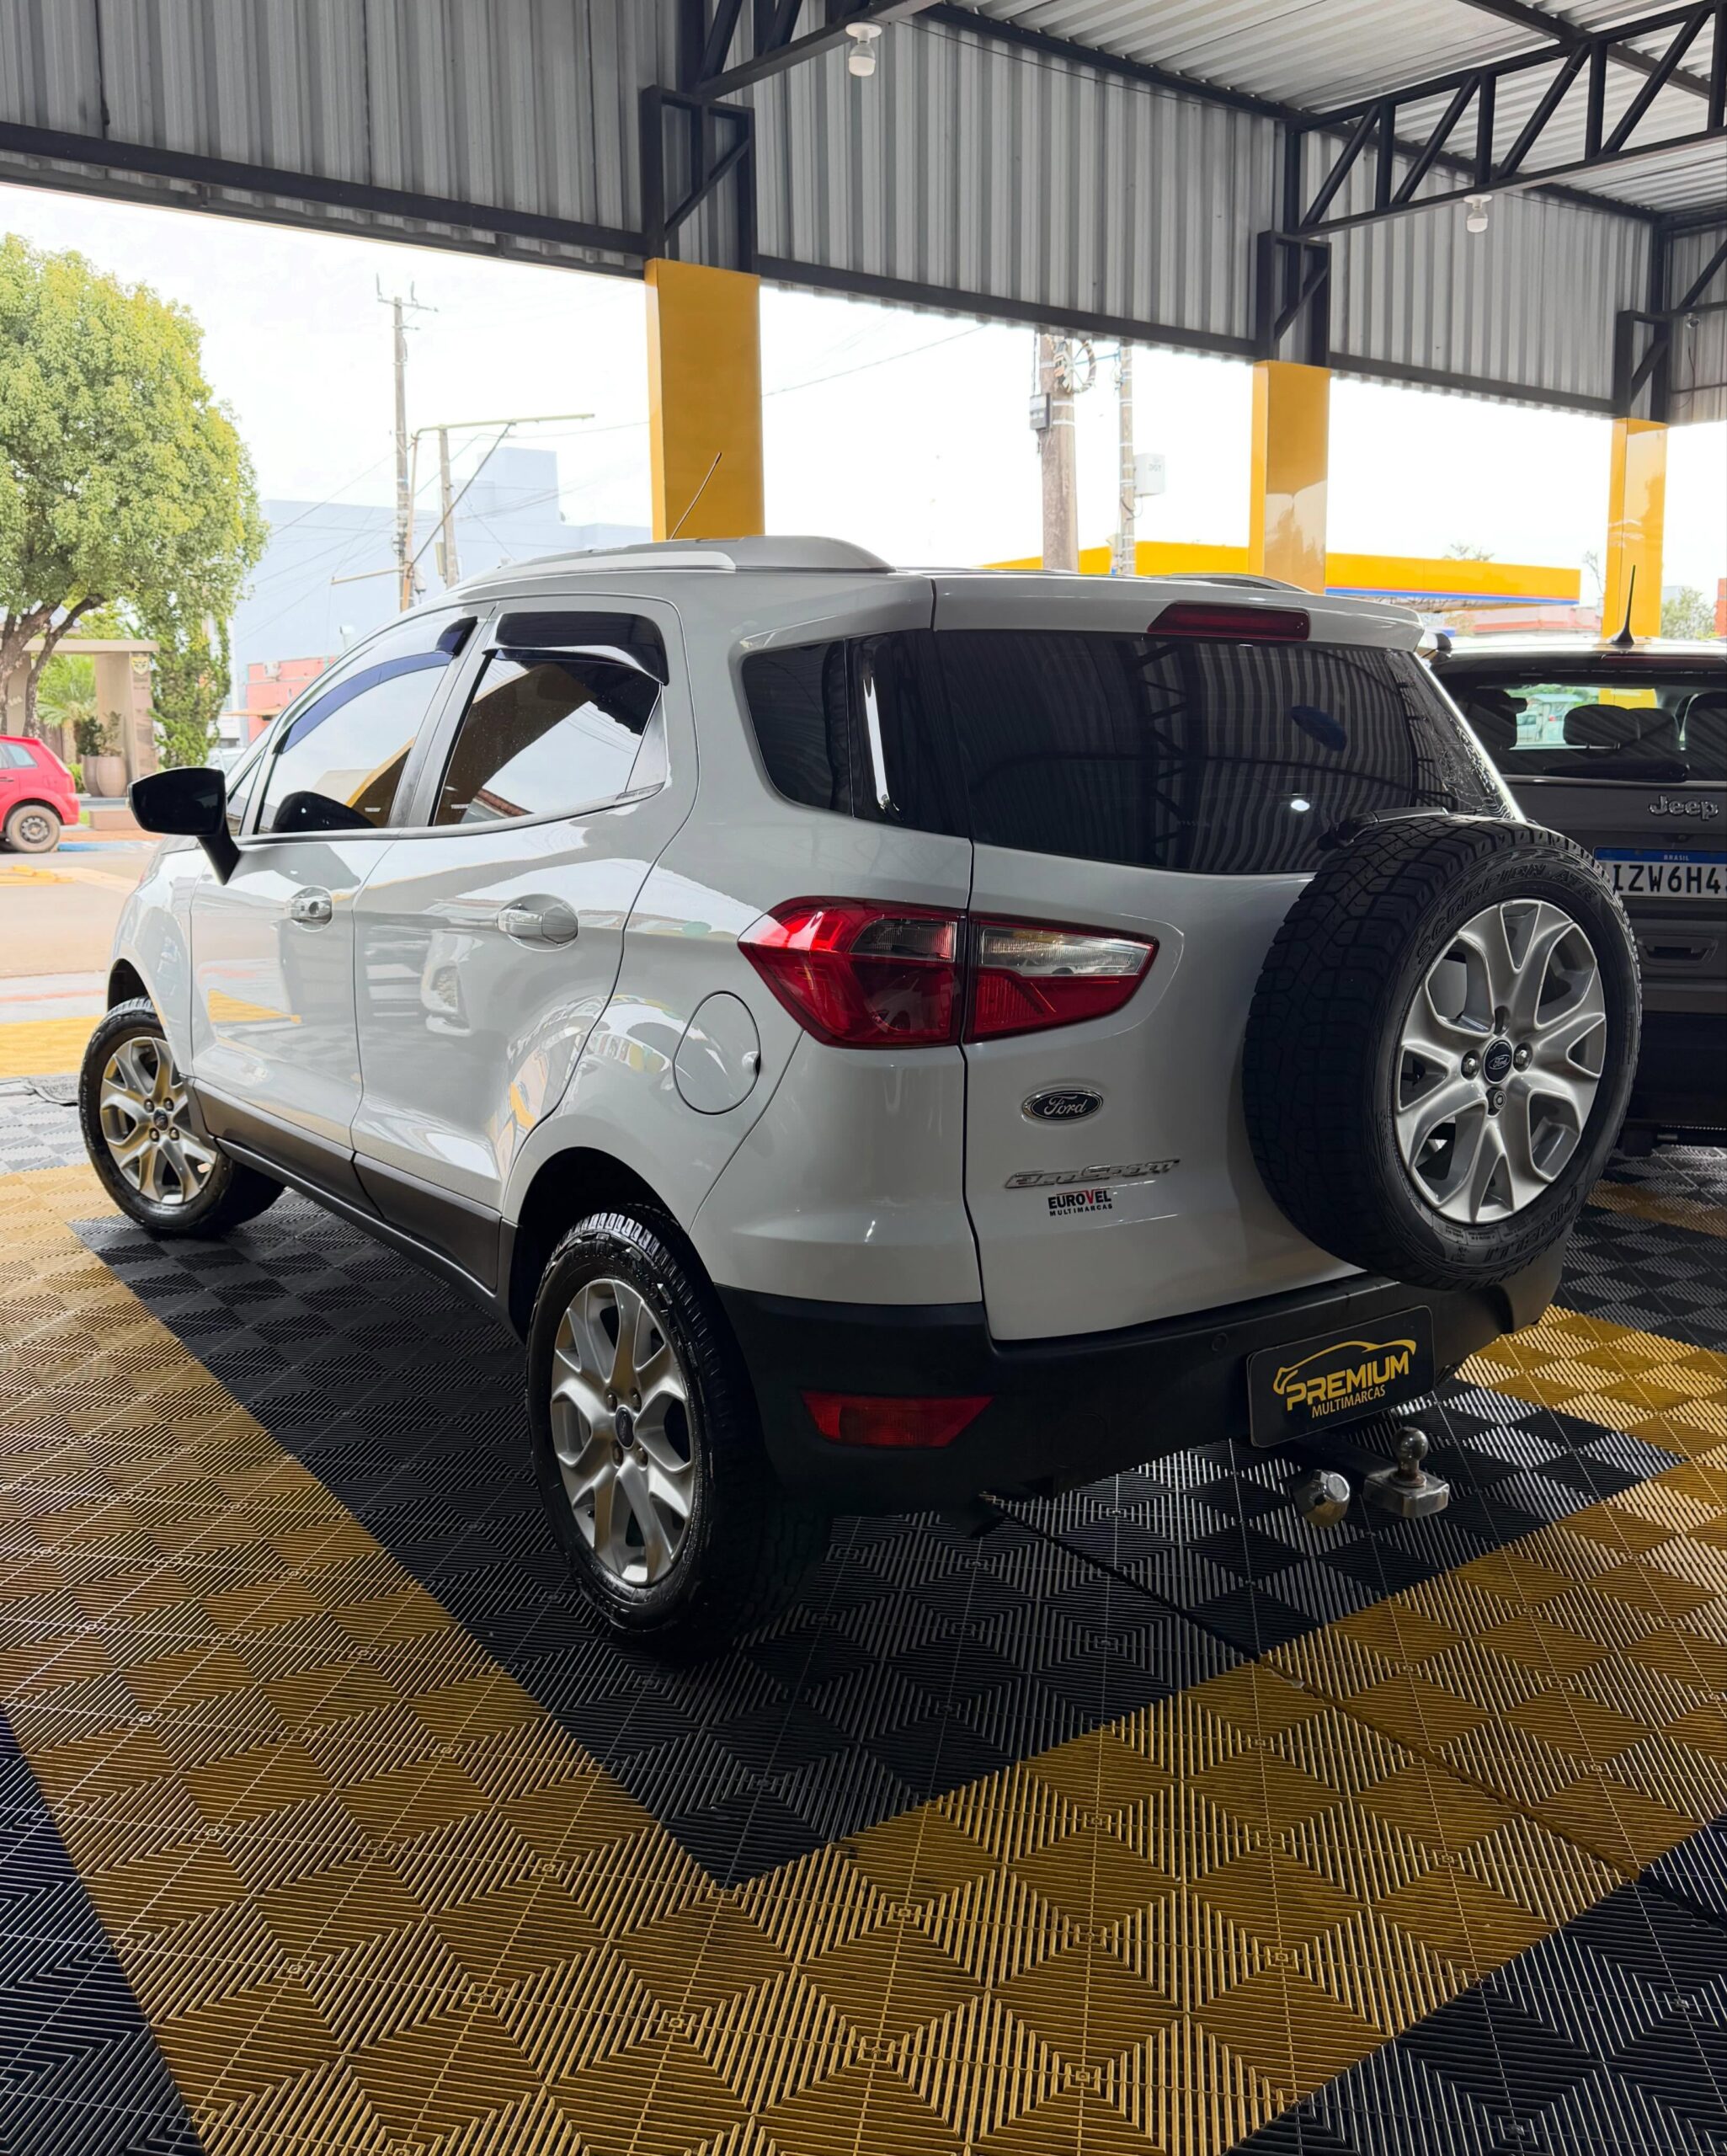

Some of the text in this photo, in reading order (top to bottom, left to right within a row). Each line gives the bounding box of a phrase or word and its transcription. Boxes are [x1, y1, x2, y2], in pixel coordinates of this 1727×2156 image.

[1648, 794, 1719, 822] Jeep
[1612, 864, 1727, 895] IZW6H4
[1417, 862, 1547, 965] SCORPION
[1043, 1095, 1089, 1116] Ford
[1048, 1188, 1111, 1209] EUROVEL
[1049, 1203, 1113, 1217] MULTIMARCAS
[1286, 1351, 1409, 1412] PREMIUM
[1311, 1384, 1386, 1419] MULTIMARCAS
